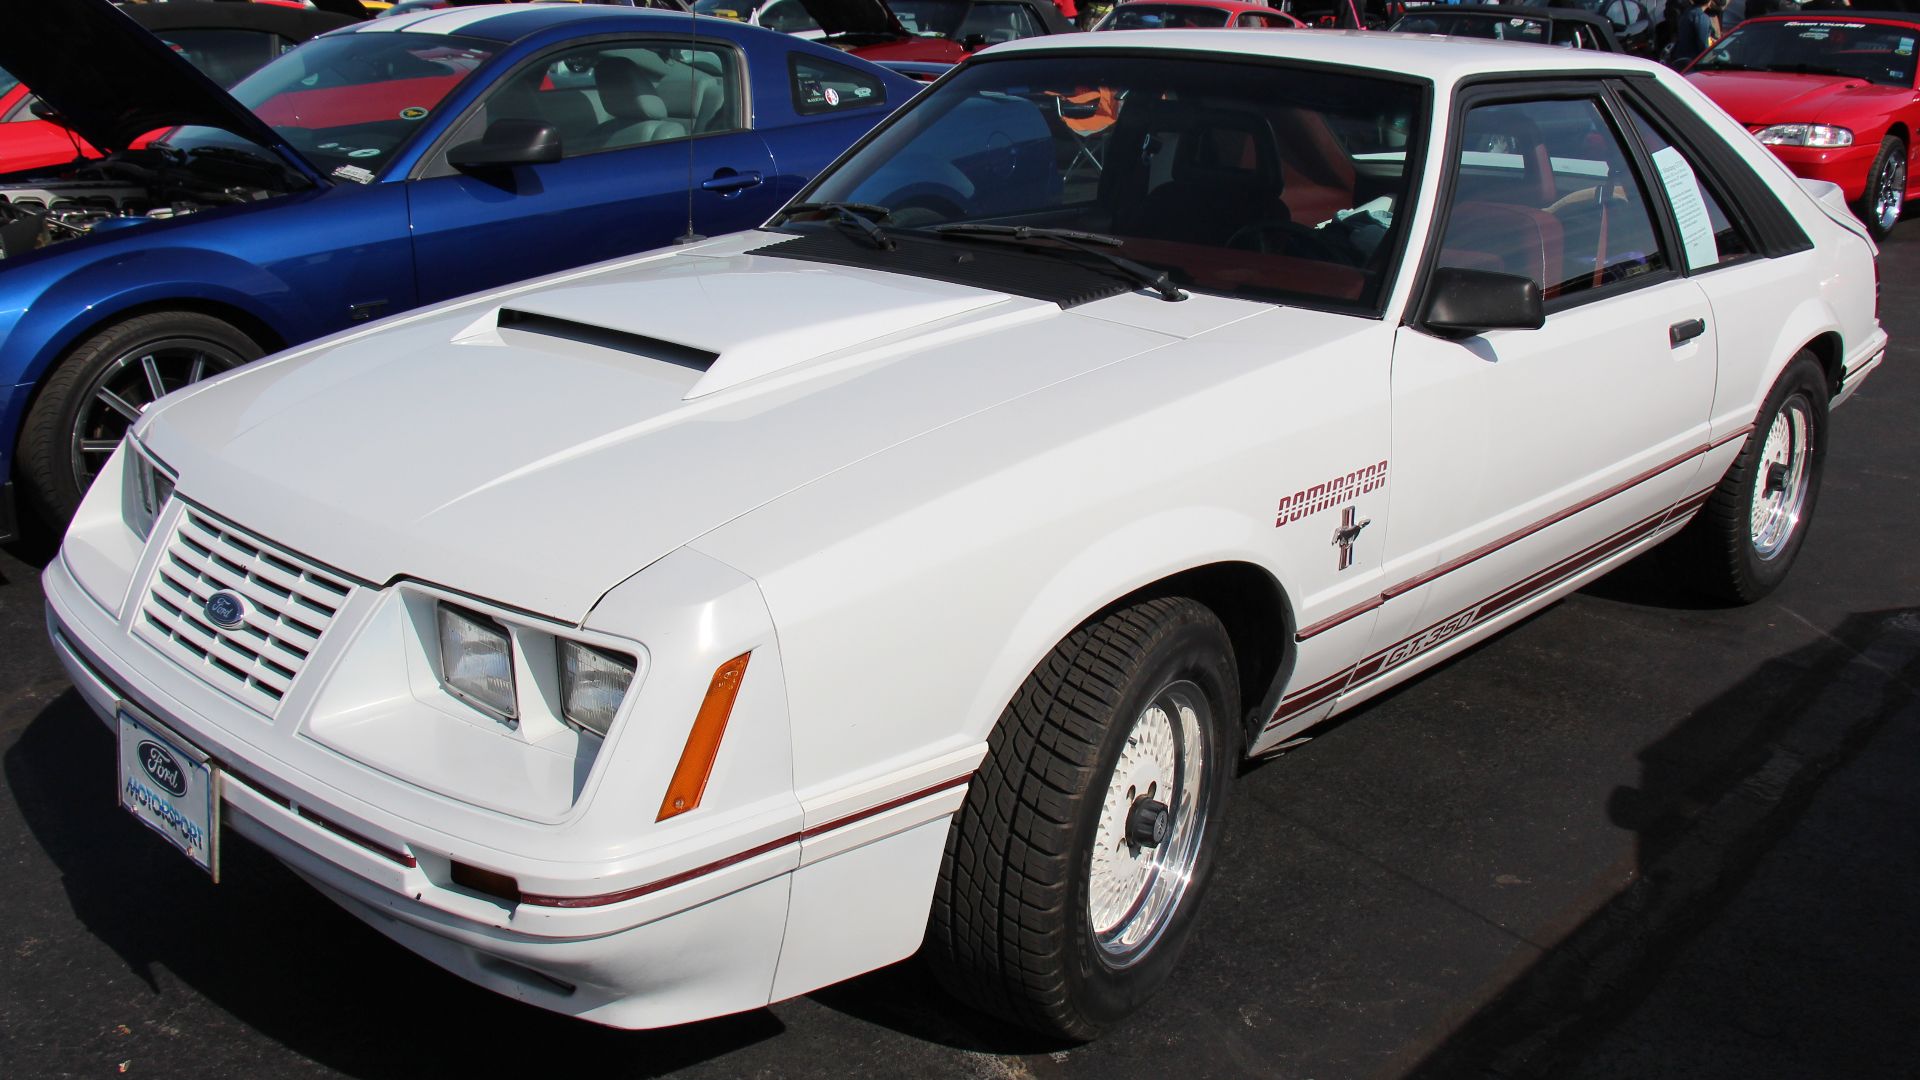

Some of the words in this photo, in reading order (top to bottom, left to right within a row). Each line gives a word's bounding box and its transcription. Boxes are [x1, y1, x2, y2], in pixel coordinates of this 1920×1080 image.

[1275, 459, 1388, 528] DOMINATOR
[147, 747, 178, 789] Ford
[126, 776, 204, 850] MOTORSPORT
